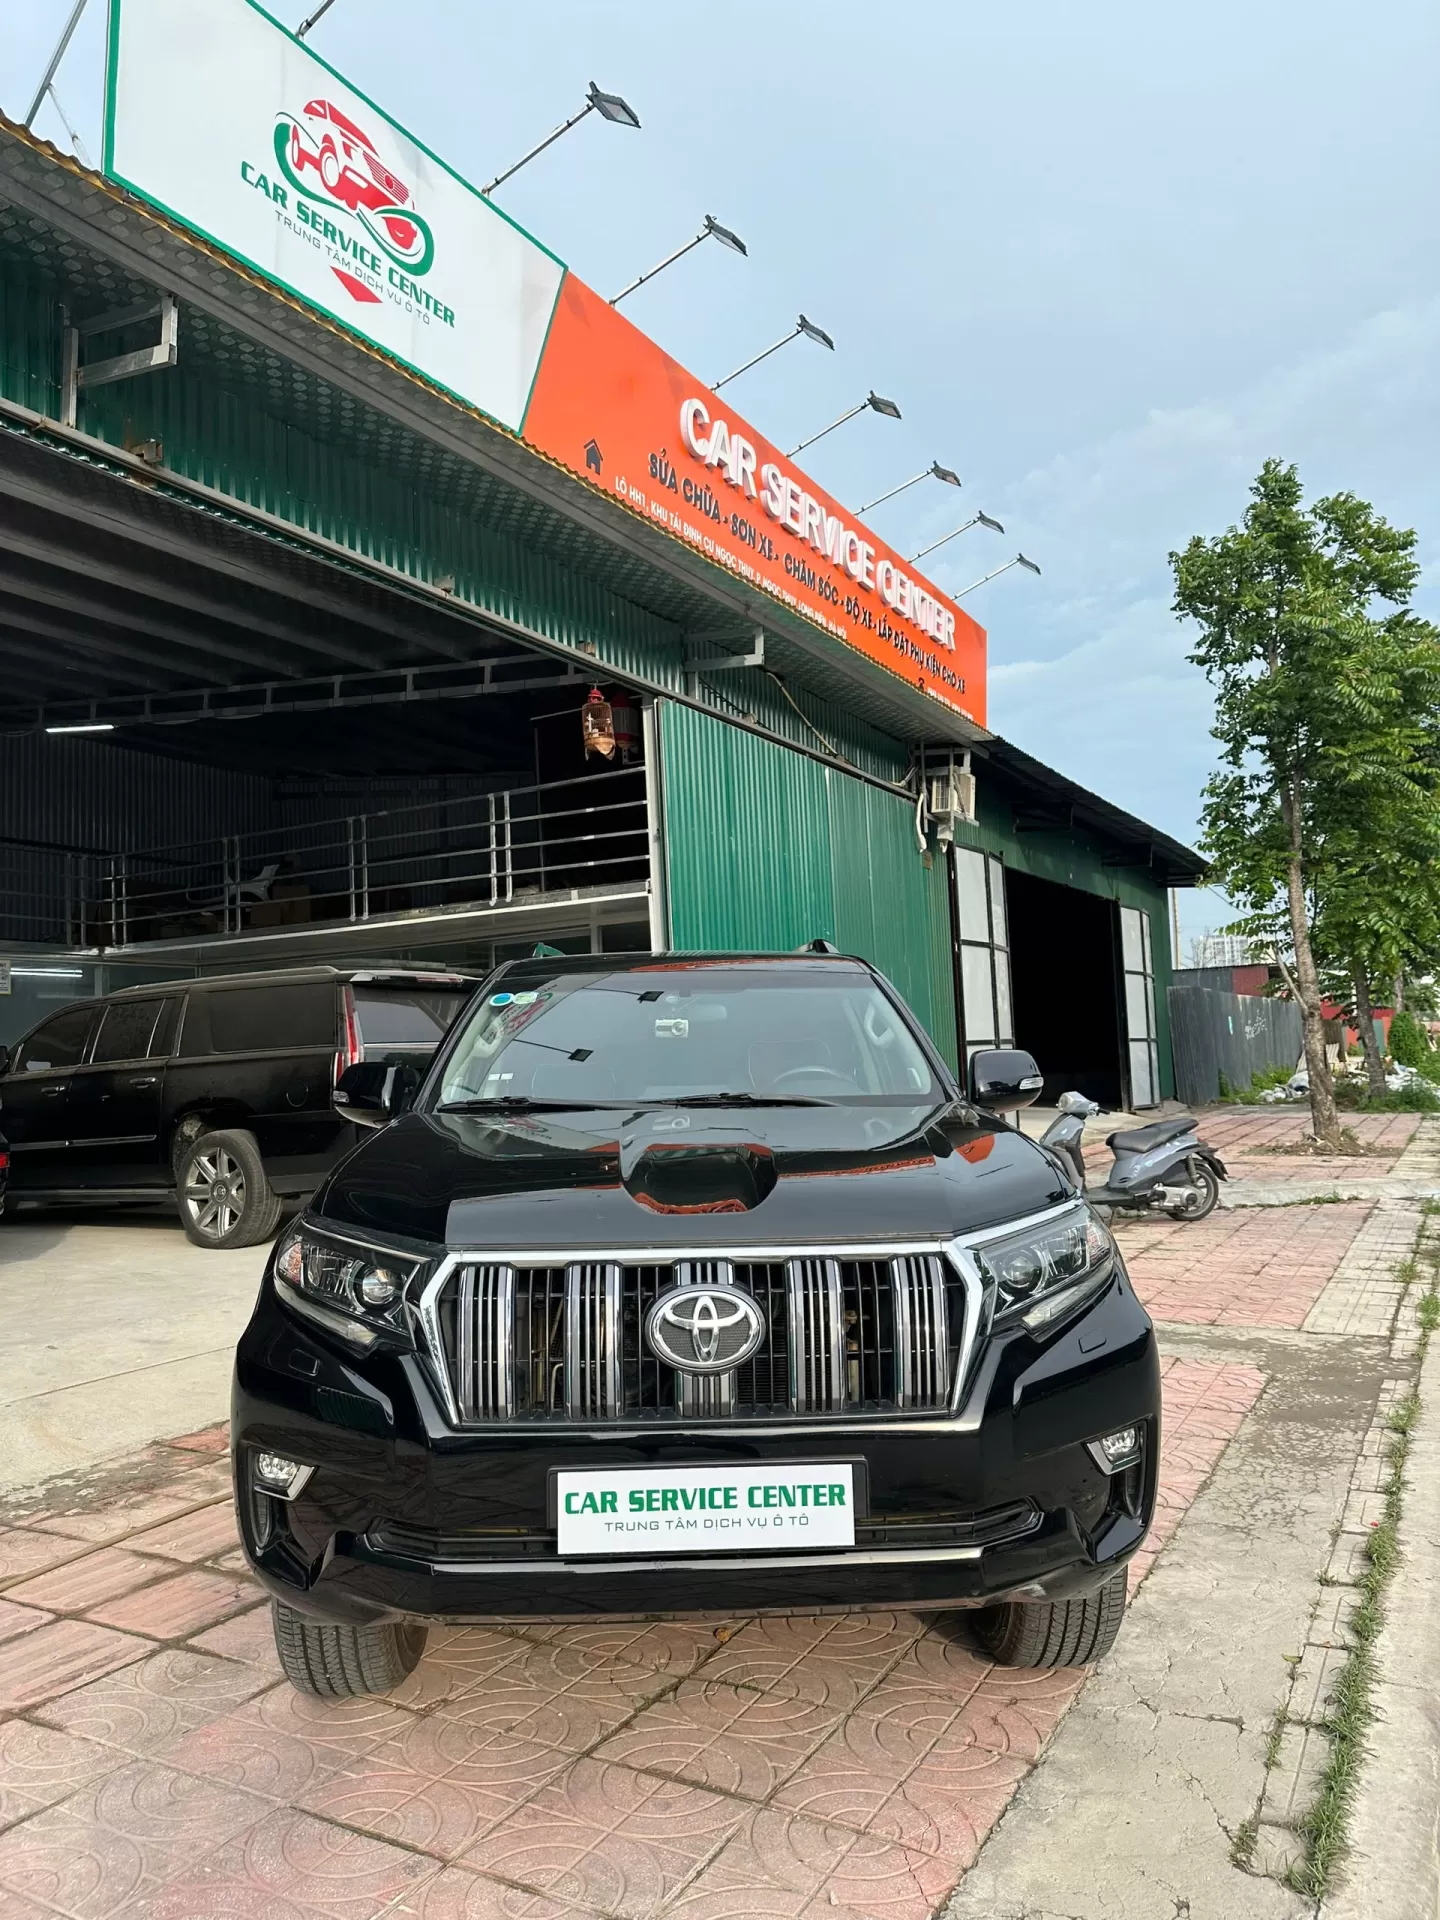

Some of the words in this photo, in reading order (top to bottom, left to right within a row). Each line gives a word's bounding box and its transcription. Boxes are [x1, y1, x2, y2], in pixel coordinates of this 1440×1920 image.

[241, 161, 288, 210] CAR
[296, 200, 382, 276] SERVICE
[388, 266, 455, 328] CENTER
[275, 210, 321, 250] TRUNG
[325, 244, 351, 271] TÂM
[615, 475, 627, 495] LÔ
[651, 500, 668, 522] KHU
[669, 511, 682, 532] TÁI
[680, 398, 758, 501] CAR
[760, 464, 876, 592] SERVICE
[876, 560, 957, 651] CENTER
[648, 448, 678, 494] SỬA
[681, 477, 721, 525] CHỮA
[730, 512, 756, 550] SƠN
[758, 532, 773, 561] XE
[783, 553, 815, 591] CHĂM
[817, 575, 839, 606] SÓC
[845, 595, 860, 625] ĐỘ
[861, 606, 872, 630] XE
[941, 666, 957, 688] CHO
[956, 675, 965, 694] XE
[565, 1490, 618, 1515] CAR
[629, 1486, 738, 1512] SERVICE
[747, 1483, 847, 1508] CENTER
[604, 1520, 660, 1533] TRUNG
[665, 1516, 698, 1530] TÂM
[703, 1517, 742, 1531] DỊCH
[747, 1516, 767, 1530] VỤ
[772, 1513, 784, 1527] Ô
[790, 1512, 810, 1527] TÔ
